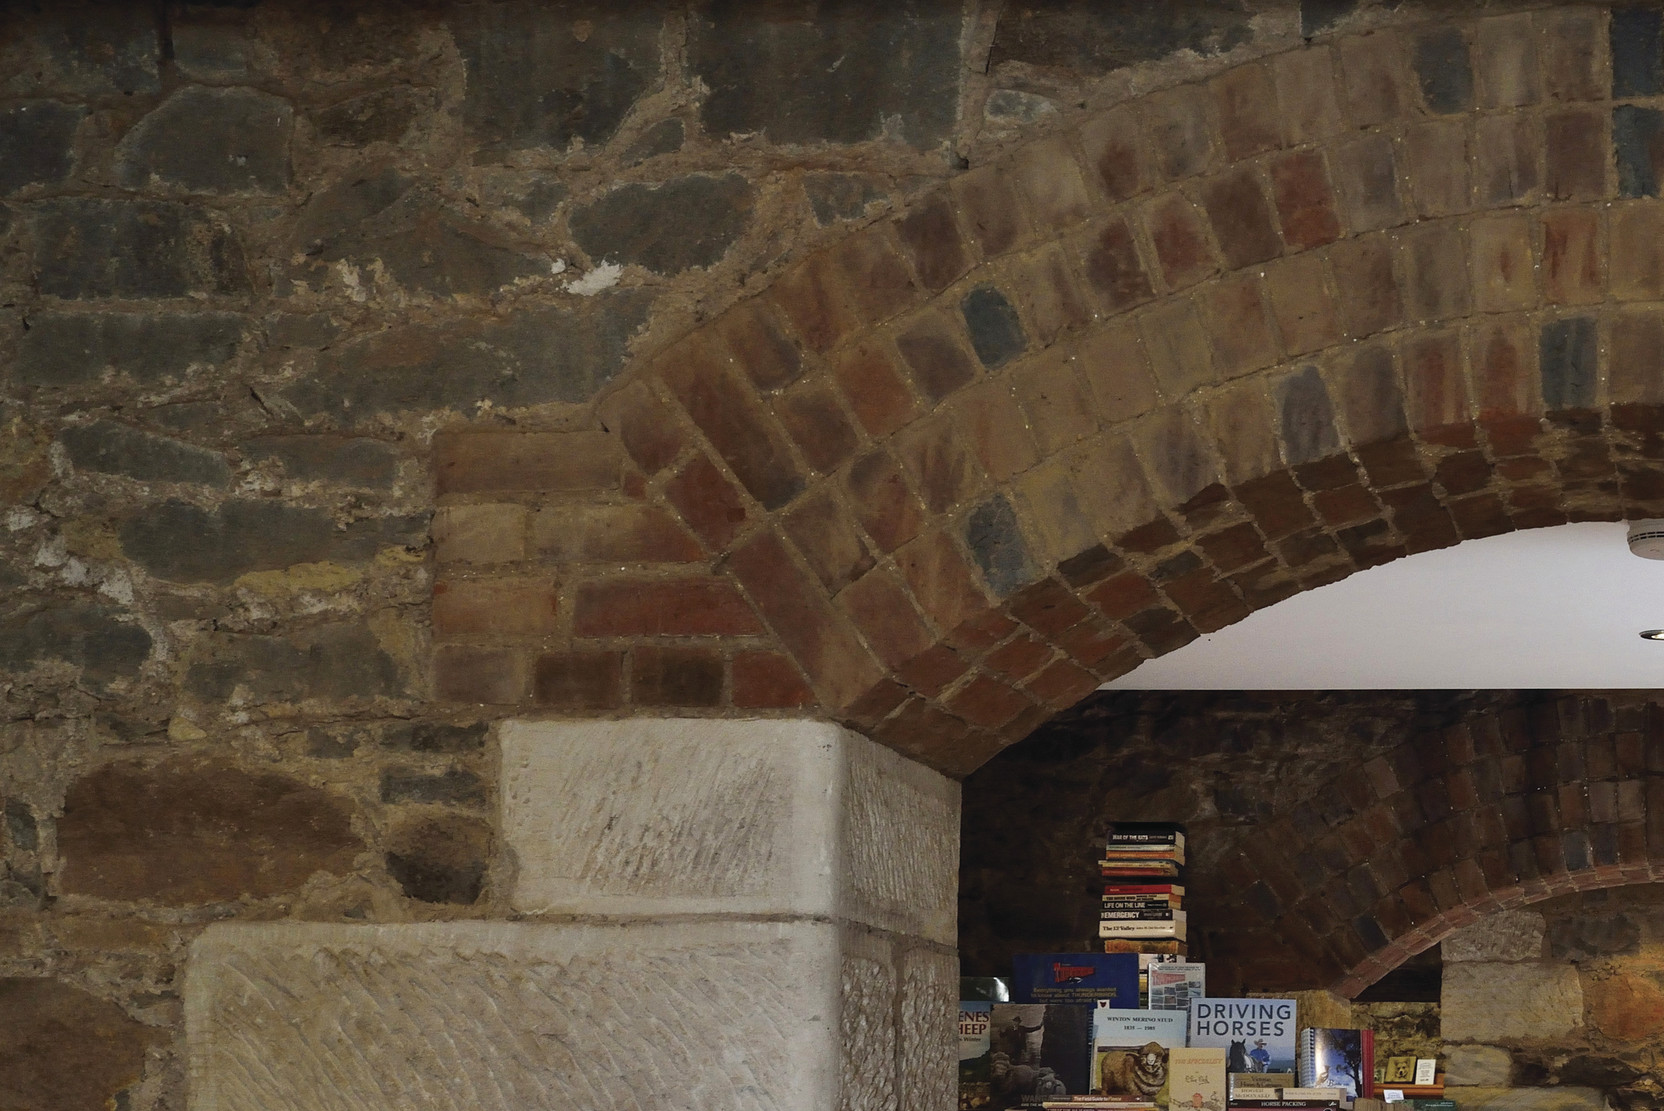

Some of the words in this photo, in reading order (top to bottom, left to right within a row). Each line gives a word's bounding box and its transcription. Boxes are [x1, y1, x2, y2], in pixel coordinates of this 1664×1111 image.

[1105, 911, 1140, 919] EMERGENCY
[1197, 1004, 1291, 1019] DRIVING
[1197, 1021, 1285, 1036] HORSES
